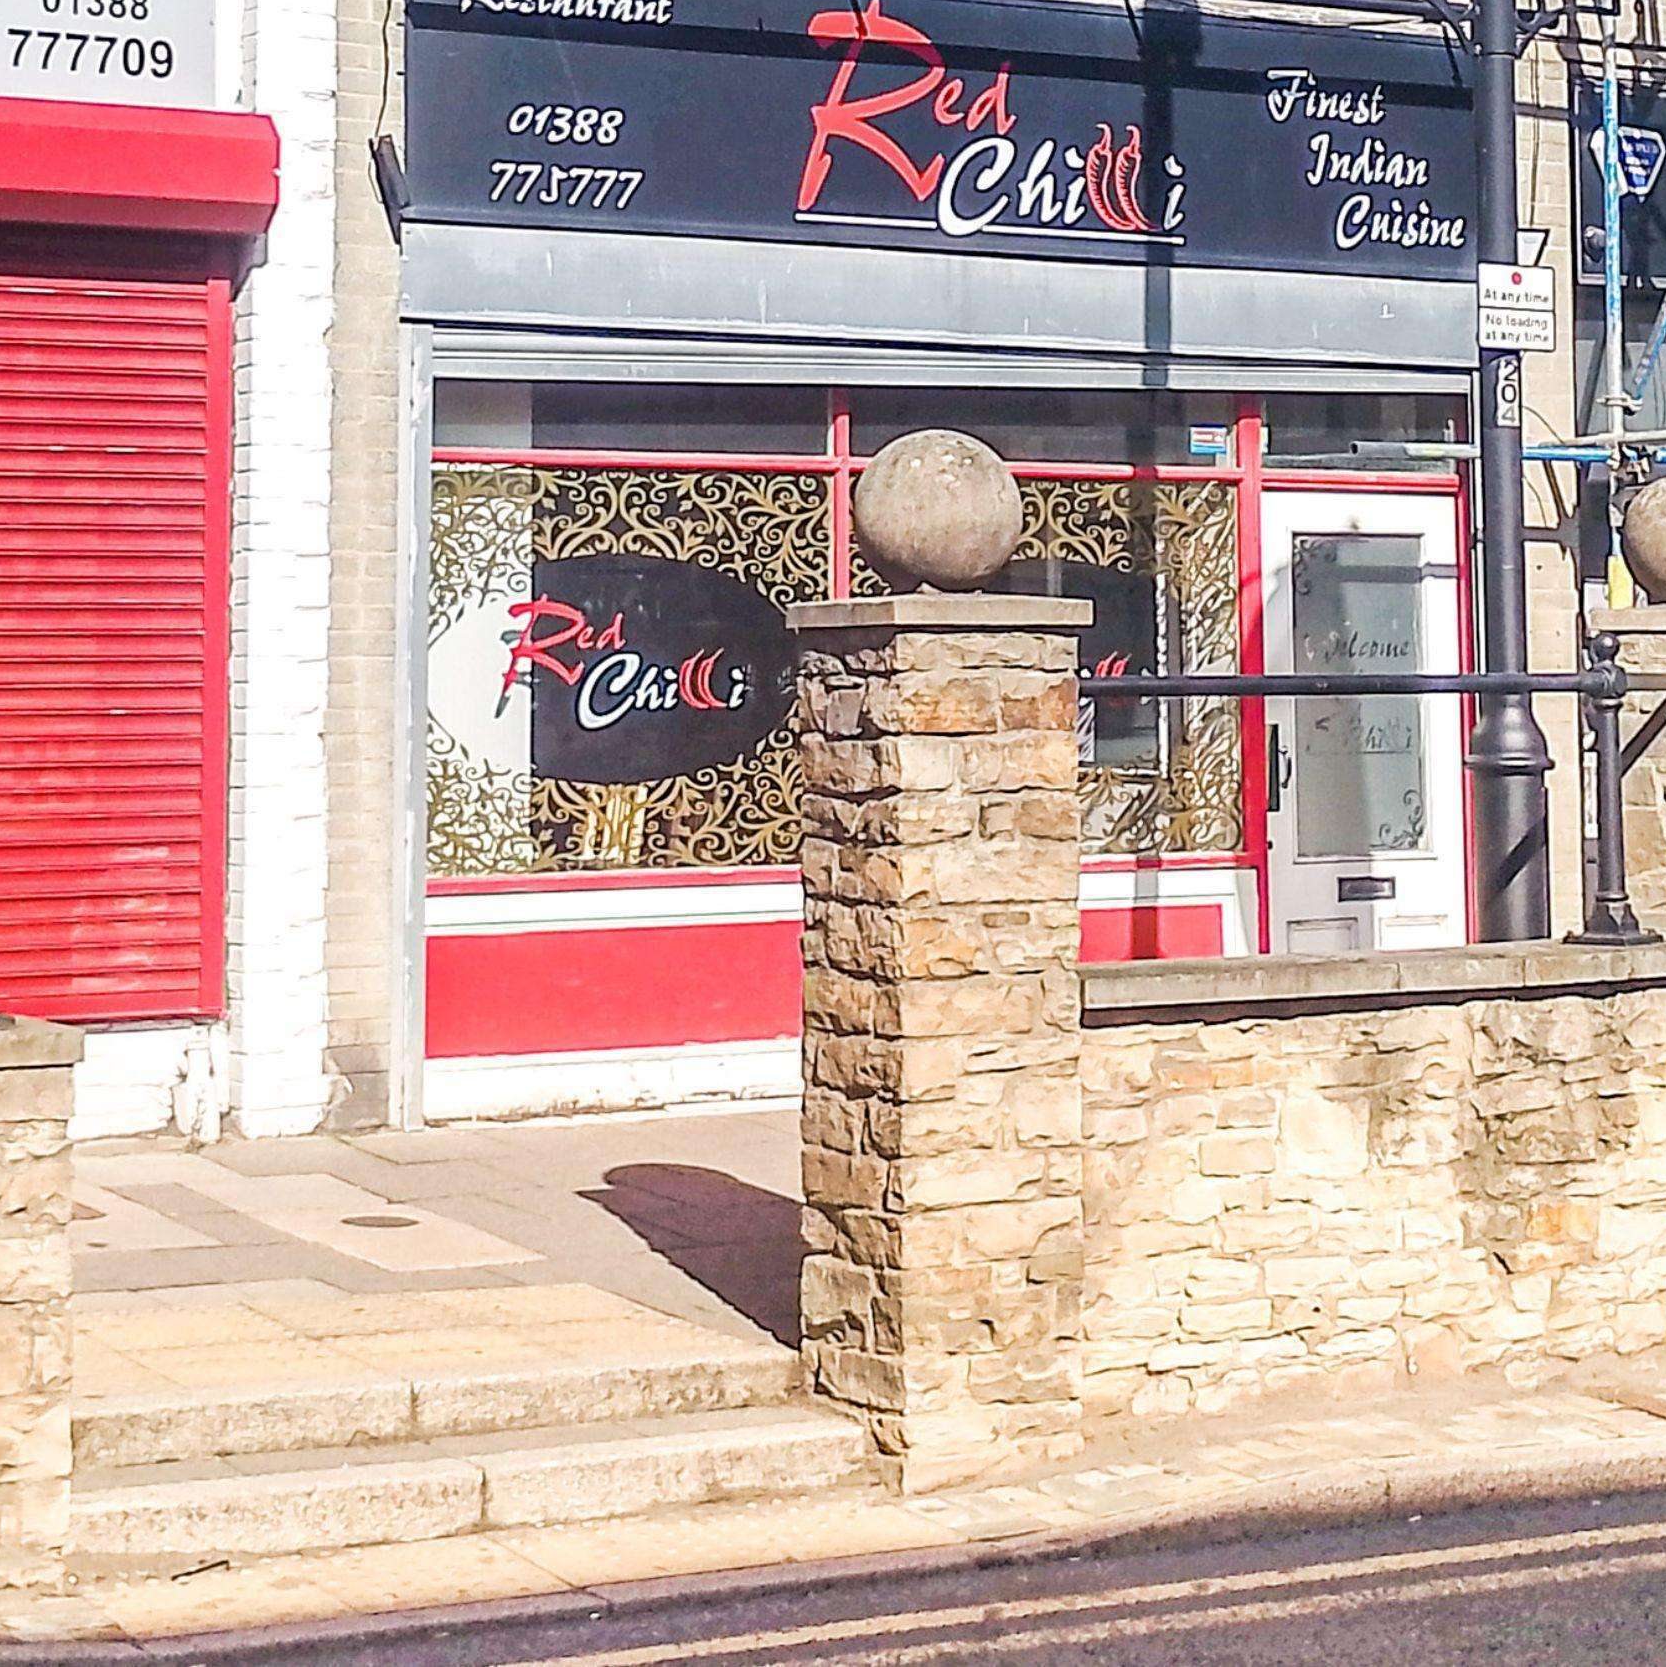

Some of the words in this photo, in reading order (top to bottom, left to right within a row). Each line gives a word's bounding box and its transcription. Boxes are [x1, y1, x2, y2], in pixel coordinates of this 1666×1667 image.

[7, 27, 174, 79] 777709
[507, 104, 624, 145] 01388
[1266, 68, 1385, 125] Finest
[489, 160, 644, 210] 775777
[936, 123, 1186, 237] Chilli
[1306, 132, 1429, 189] Indian
[1335, 193, 1467, 250] Cuisine
[1483, 288, 1497, 301] At
[1501, 290, 1521, 304] any
[1524, 289, 1550, 304] time
[1485, 313, 1503, 326] No
[1506, 314, 1548, 331] loading
[1485, 331, 1497, 341] at
[1501, 332, 1521, 345] any
[1524, 331, 1550, 343] time
[1500, 360, 1520, 423] 204
[498, 593, 626, 698] Red
[574, 648, 746, 731] Chilli
